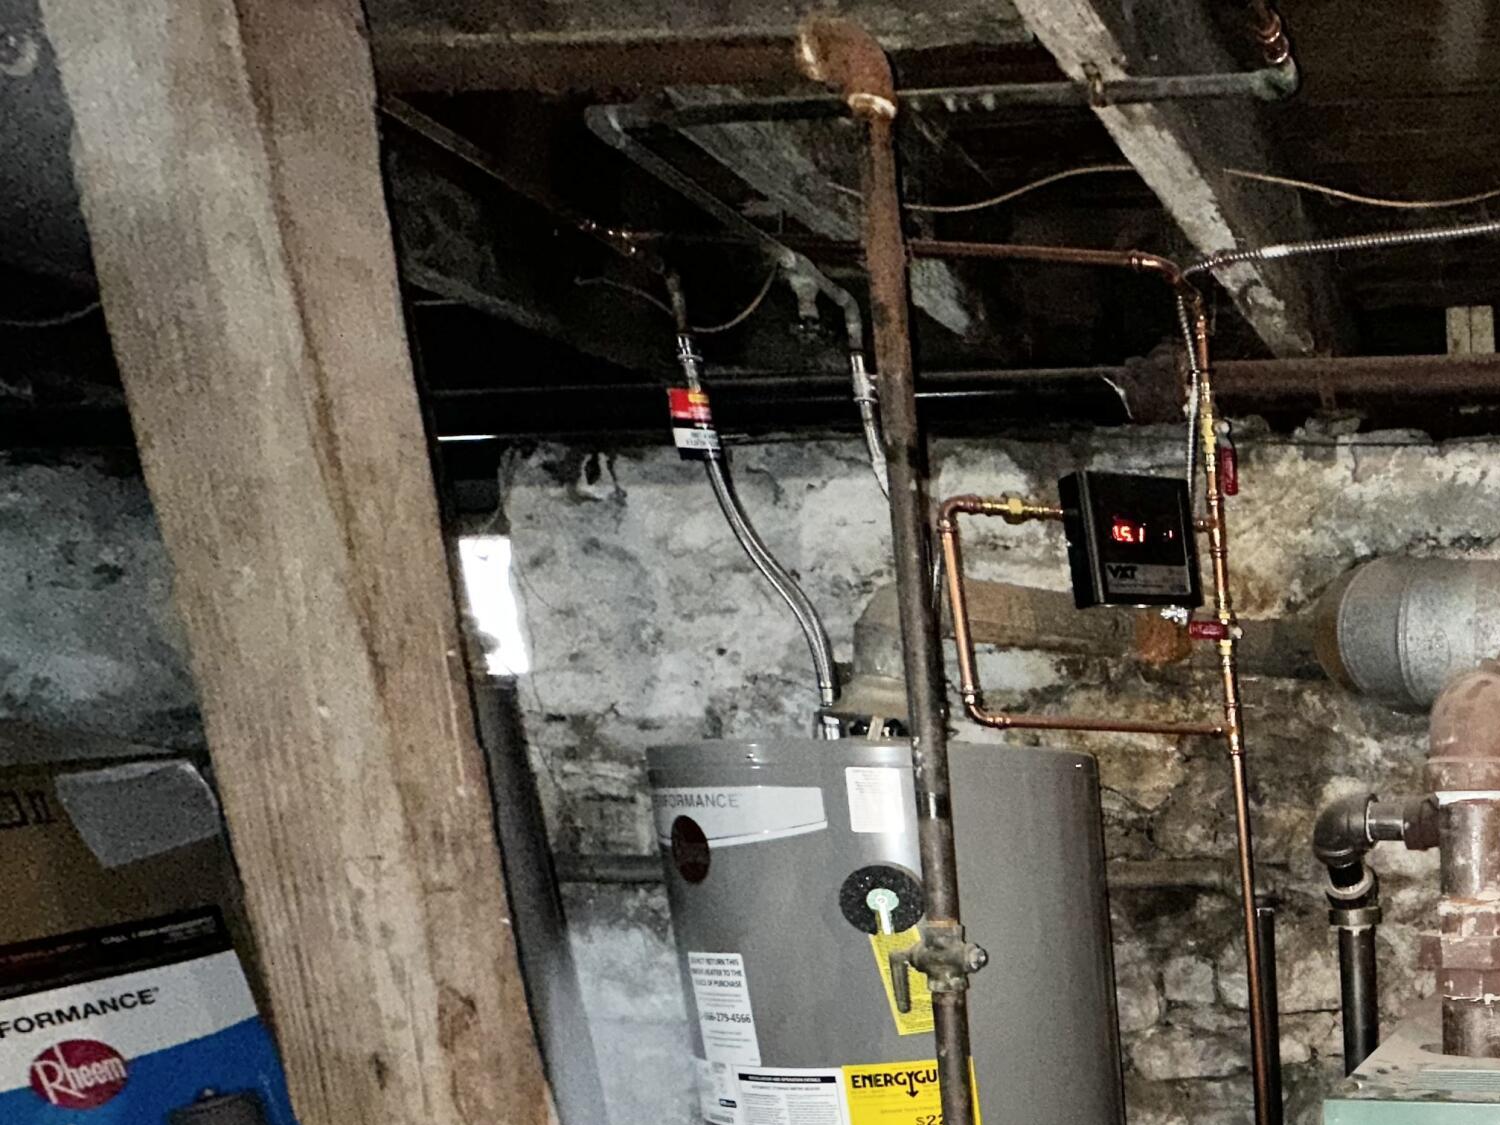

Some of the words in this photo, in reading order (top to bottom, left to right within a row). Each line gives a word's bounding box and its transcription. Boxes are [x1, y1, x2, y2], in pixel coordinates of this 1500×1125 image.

[1106, 564, 1138, 579] VXT
[655, 793, 739, 808] FORMANCE
[33, 1045, 128, 1104] Rheem
[851, 1069, 938, 1096] ENERGYGU
